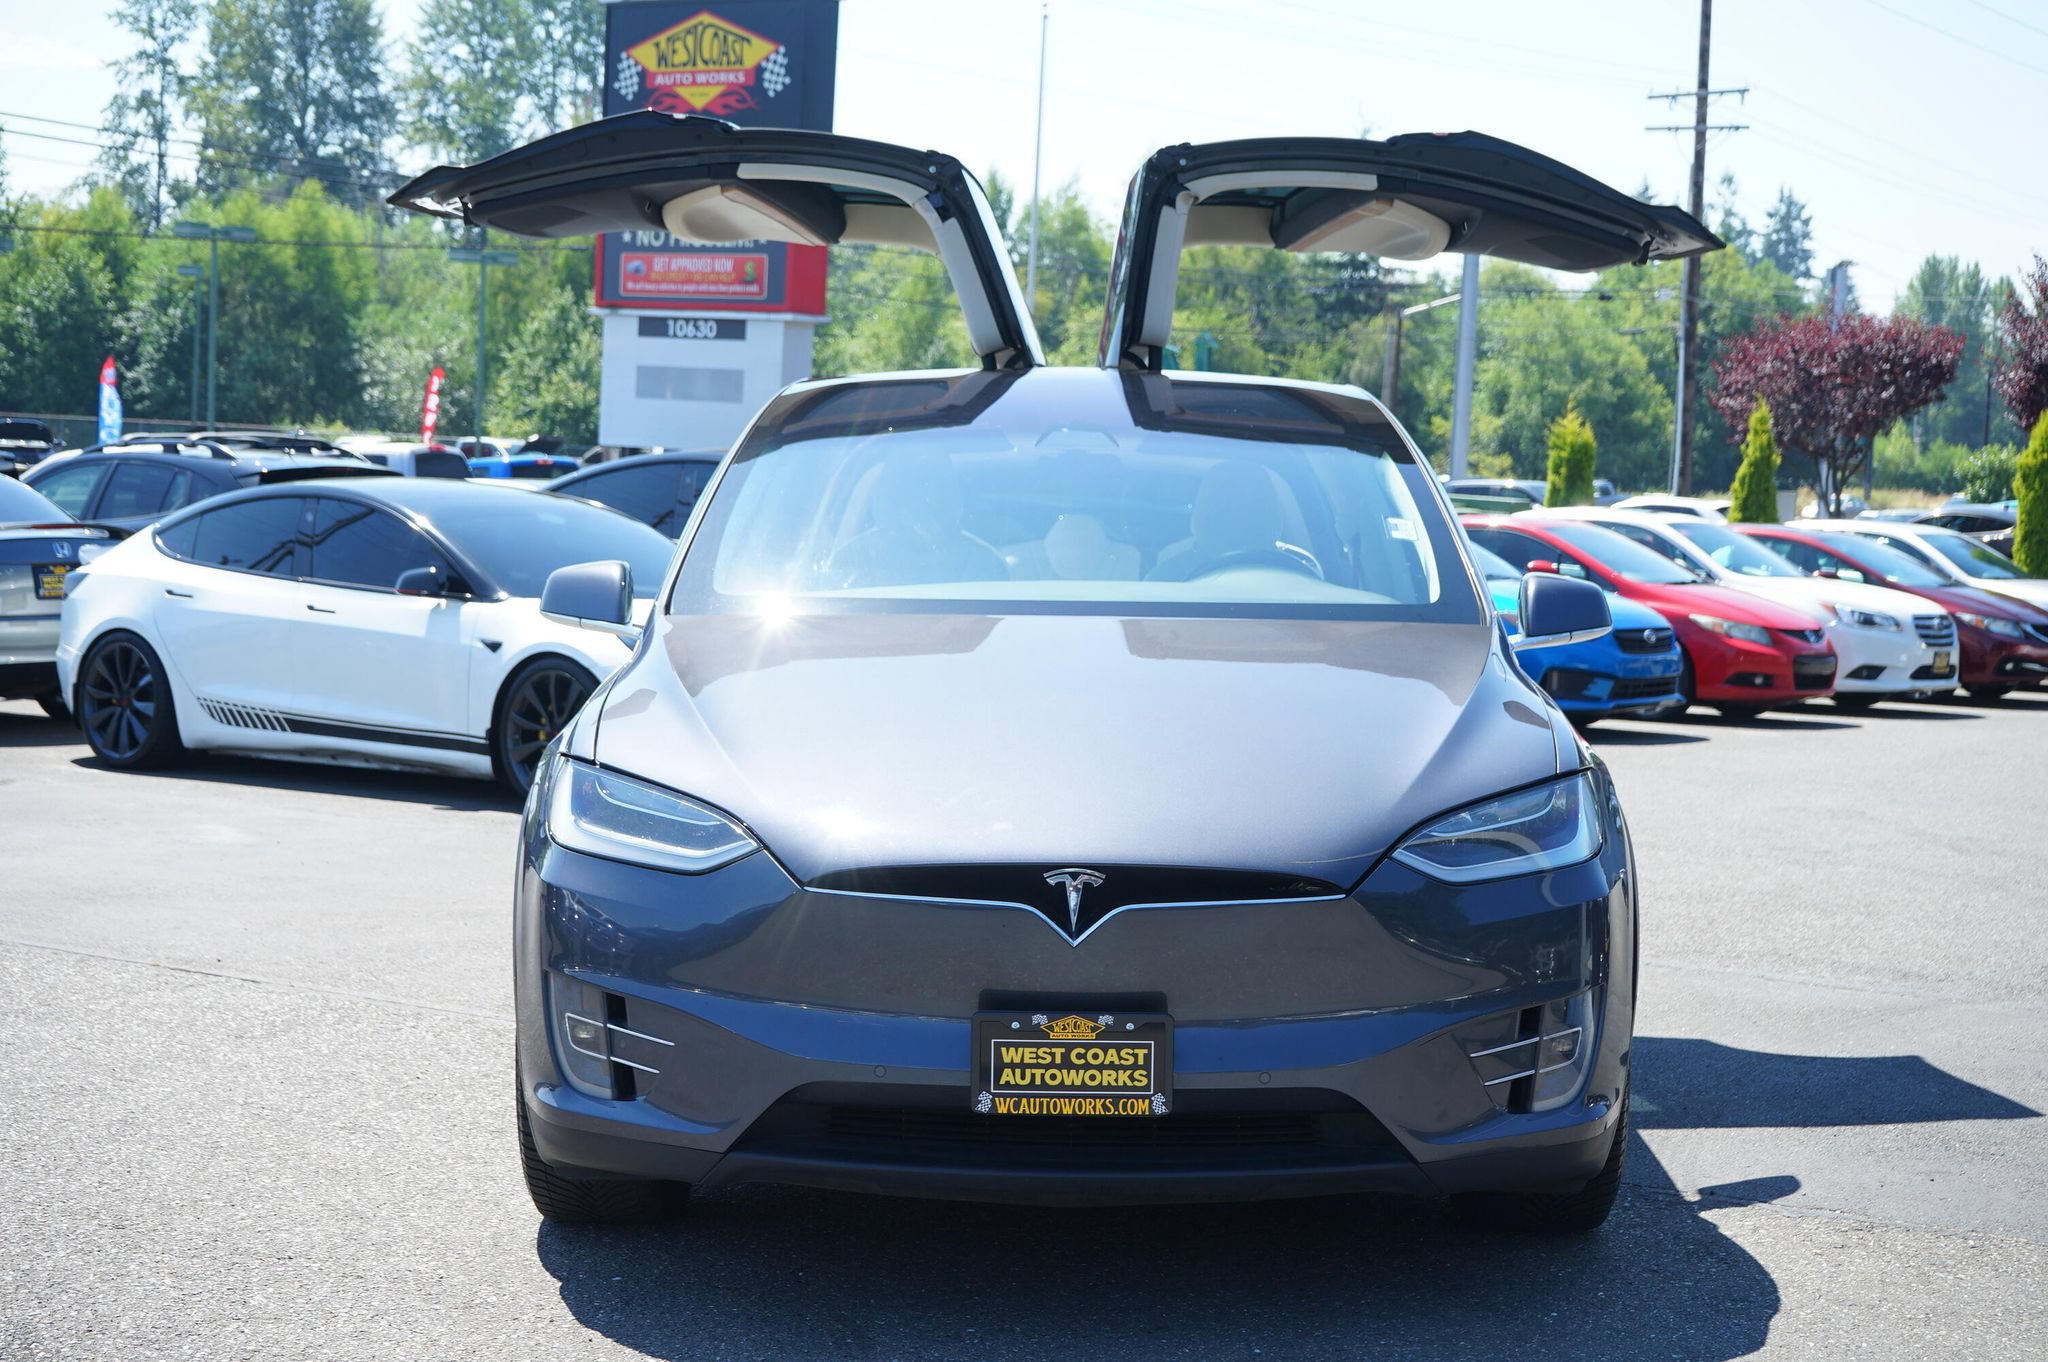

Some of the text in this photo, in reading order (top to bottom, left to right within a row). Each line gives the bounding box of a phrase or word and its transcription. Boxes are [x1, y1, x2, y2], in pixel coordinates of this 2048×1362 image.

[654, 71, 745, 86] AUTO WORKS
[635, 229, 666, 247] NO
[667, 319, 717, 338] 10630
[1001, 1047, 1148, 1065] WEST COAST
[1000, 1068, 1149, 1087] AUTOWORKS
[995, 1097, 1150, 1116] WCAUTOWORKS.COM
